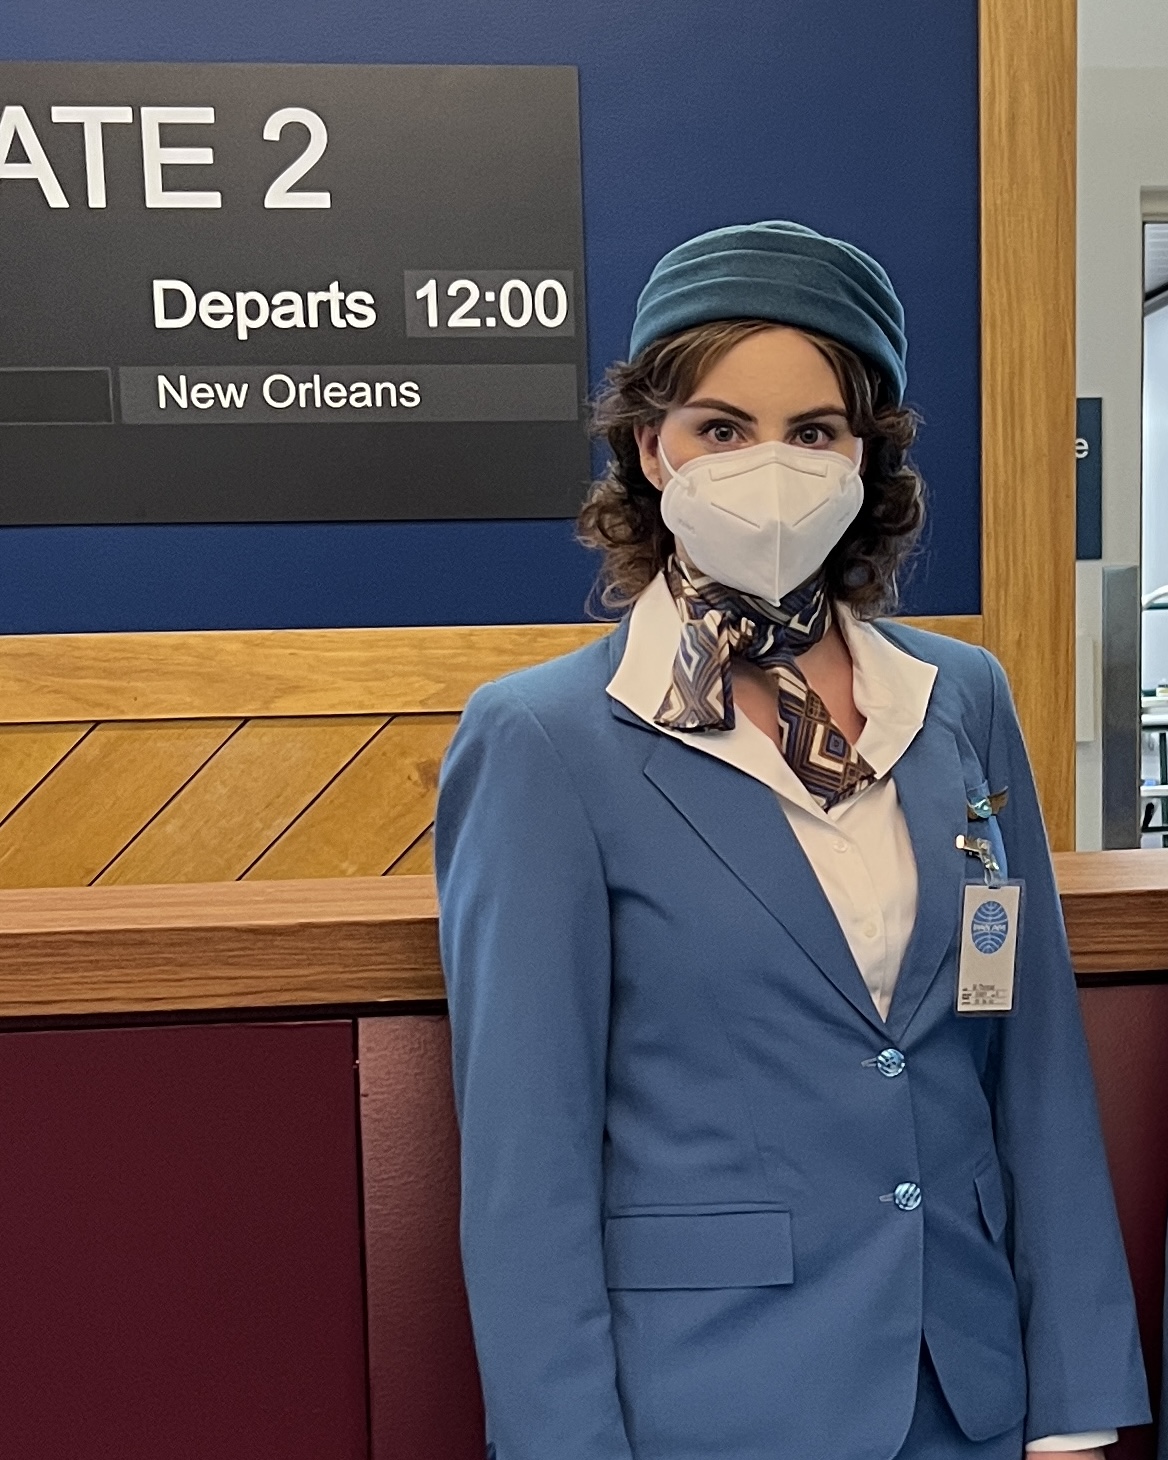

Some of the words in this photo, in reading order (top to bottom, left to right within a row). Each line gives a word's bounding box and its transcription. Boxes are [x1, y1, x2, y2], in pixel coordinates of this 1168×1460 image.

[262, 107, 331, 209] 2
[152, 279, 377, 341] Departs
[415, 279, 568, 328] 12:00
[157, 374, 249, 409] New
[262, 373, 421, 409] Orleans
